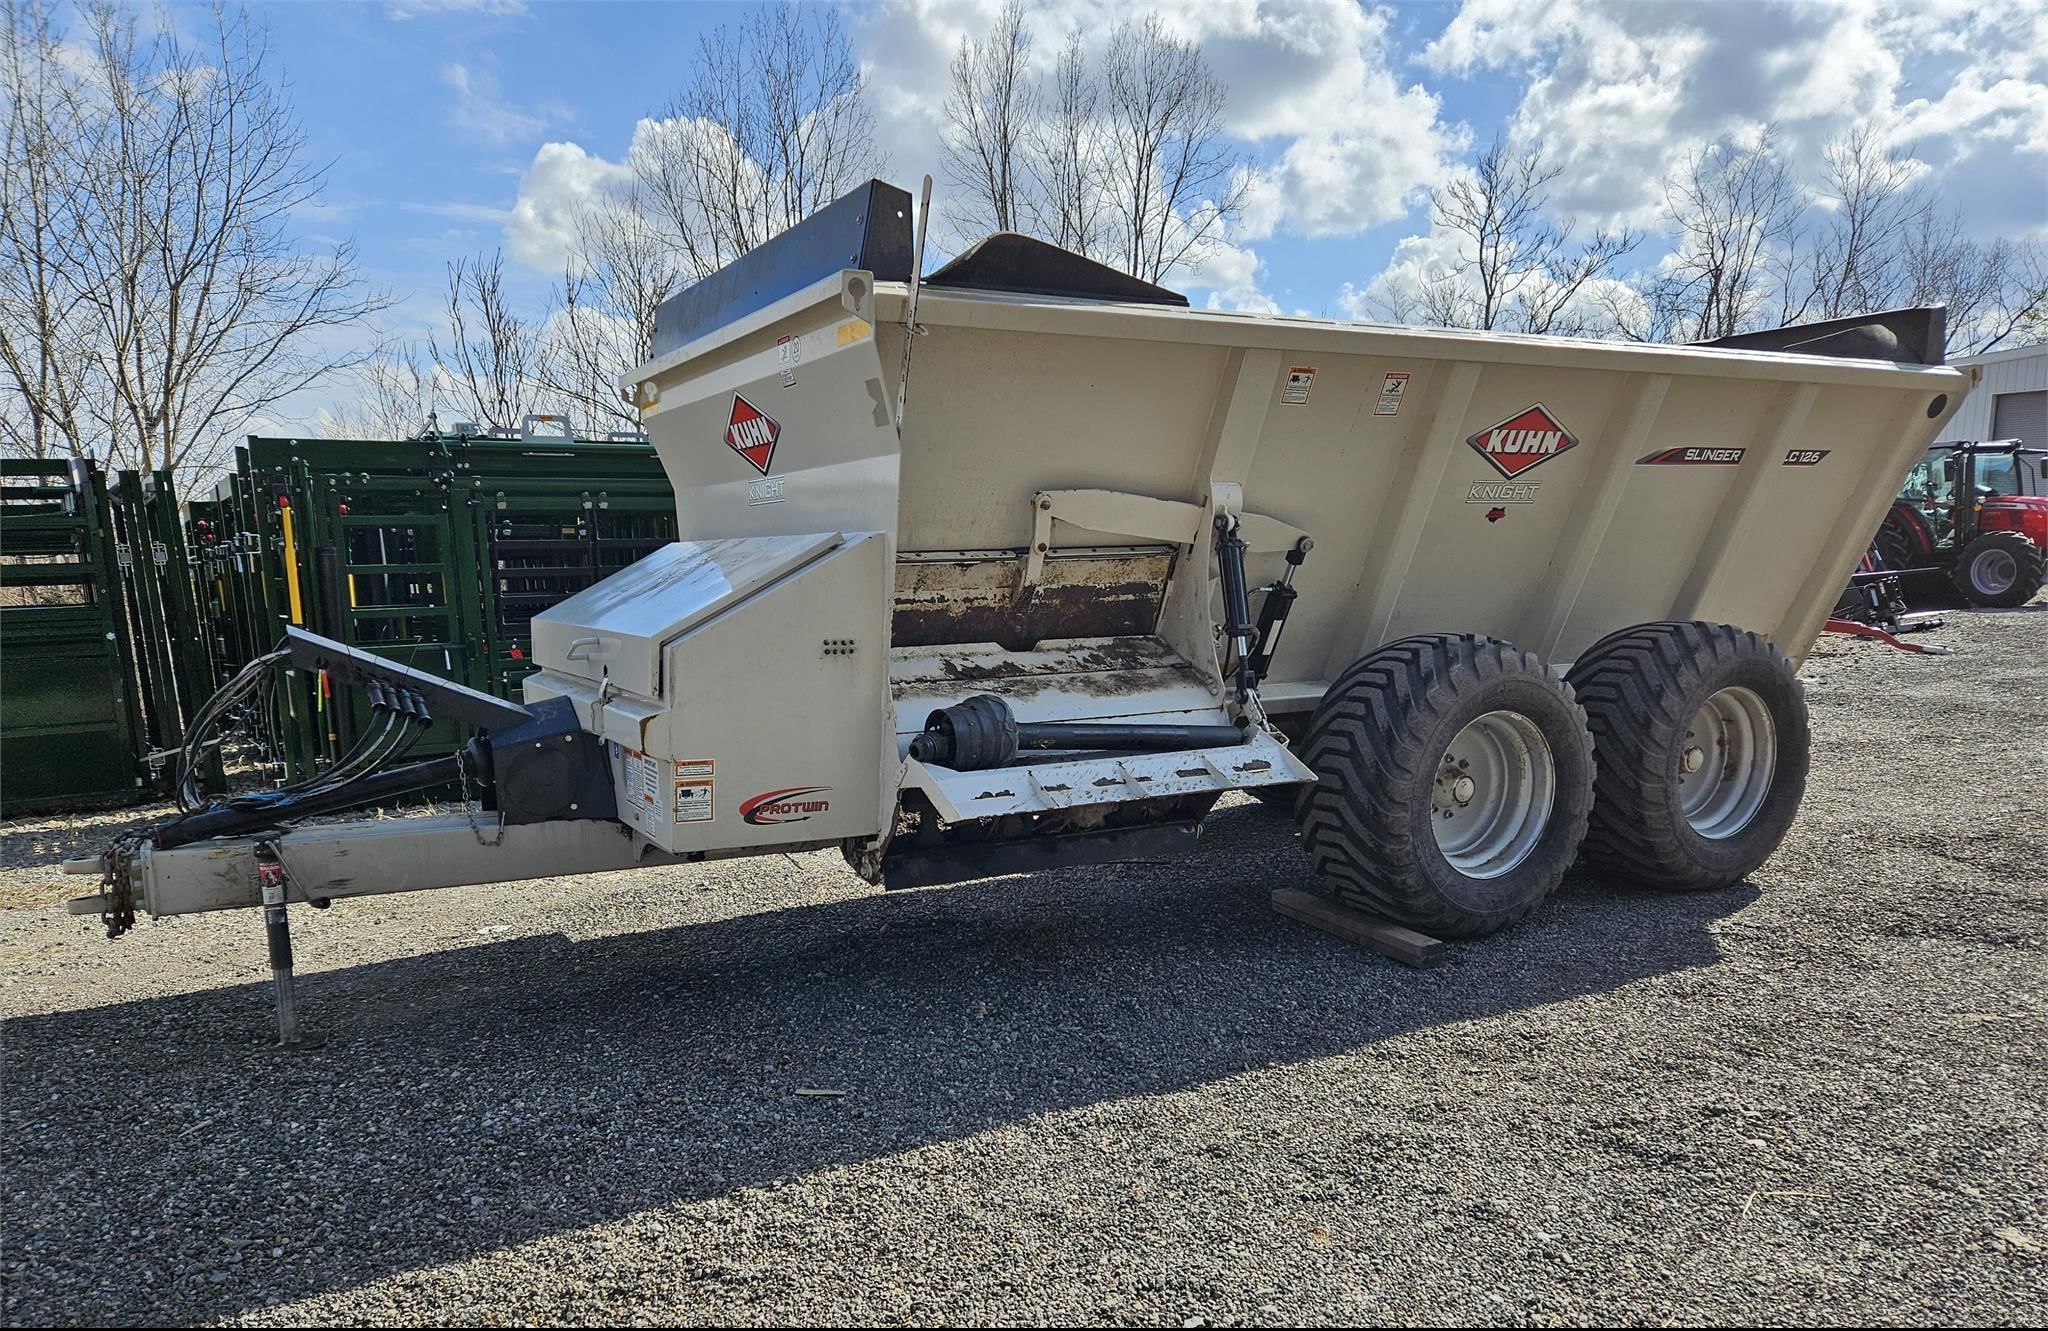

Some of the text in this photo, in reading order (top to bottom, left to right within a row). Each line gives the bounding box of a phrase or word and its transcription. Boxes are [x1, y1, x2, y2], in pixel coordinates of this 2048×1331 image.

[729, 416, 774, 450] KUHN
[1485, 429, 1563, 454] KUHN
[1684, 448, 1742, 461] SLINGER
[749, 481, 785, 501] KNIGHT
[1467, 485, 1540, 500] KNIGHT
